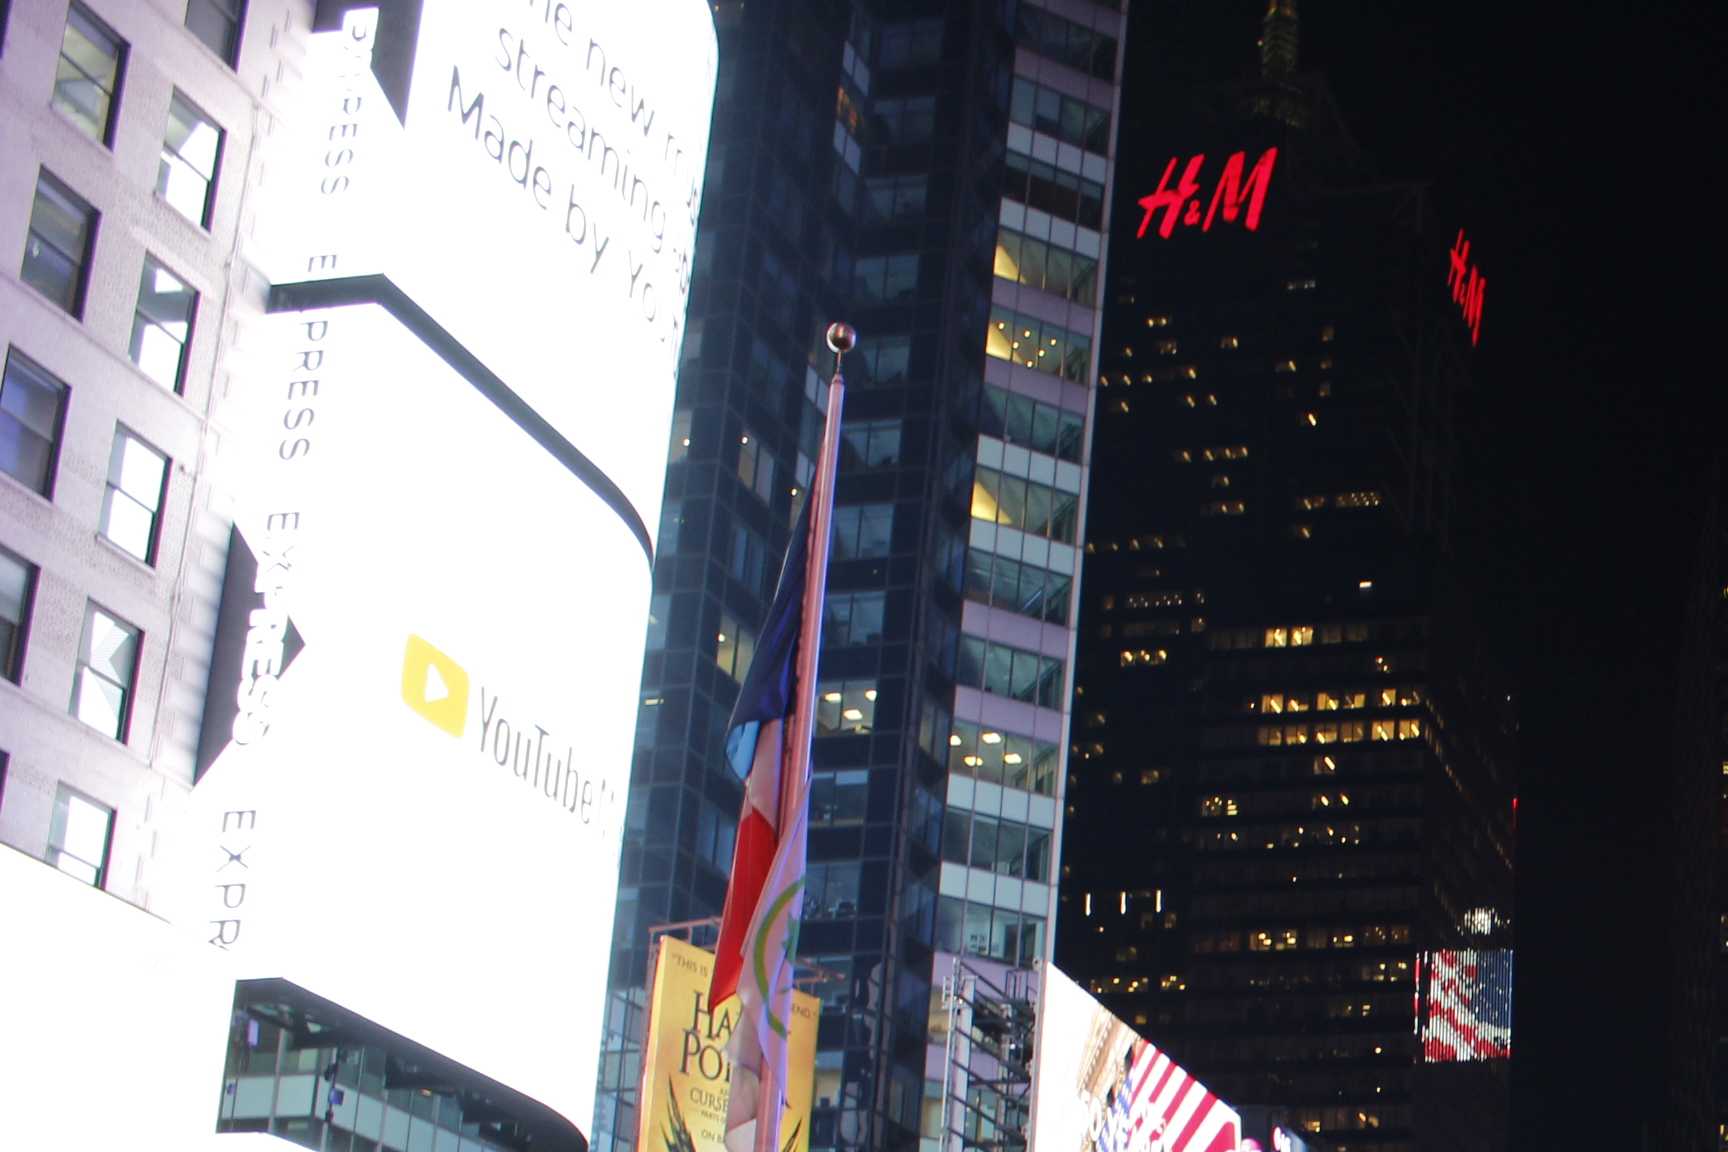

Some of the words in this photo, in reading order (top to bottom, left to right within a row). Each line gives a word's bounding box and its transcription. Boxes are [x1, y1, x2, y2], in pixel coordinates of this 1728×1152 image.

[448, 64, 552, 211] Made
[565, 183, 610, 275] by
[495, 27, 666, 254] streaming
[1137, 147, 1278, 240] H&M
[1448, 228, 1486, 348] H&M
[480, 685, 593, 825] YouTube
